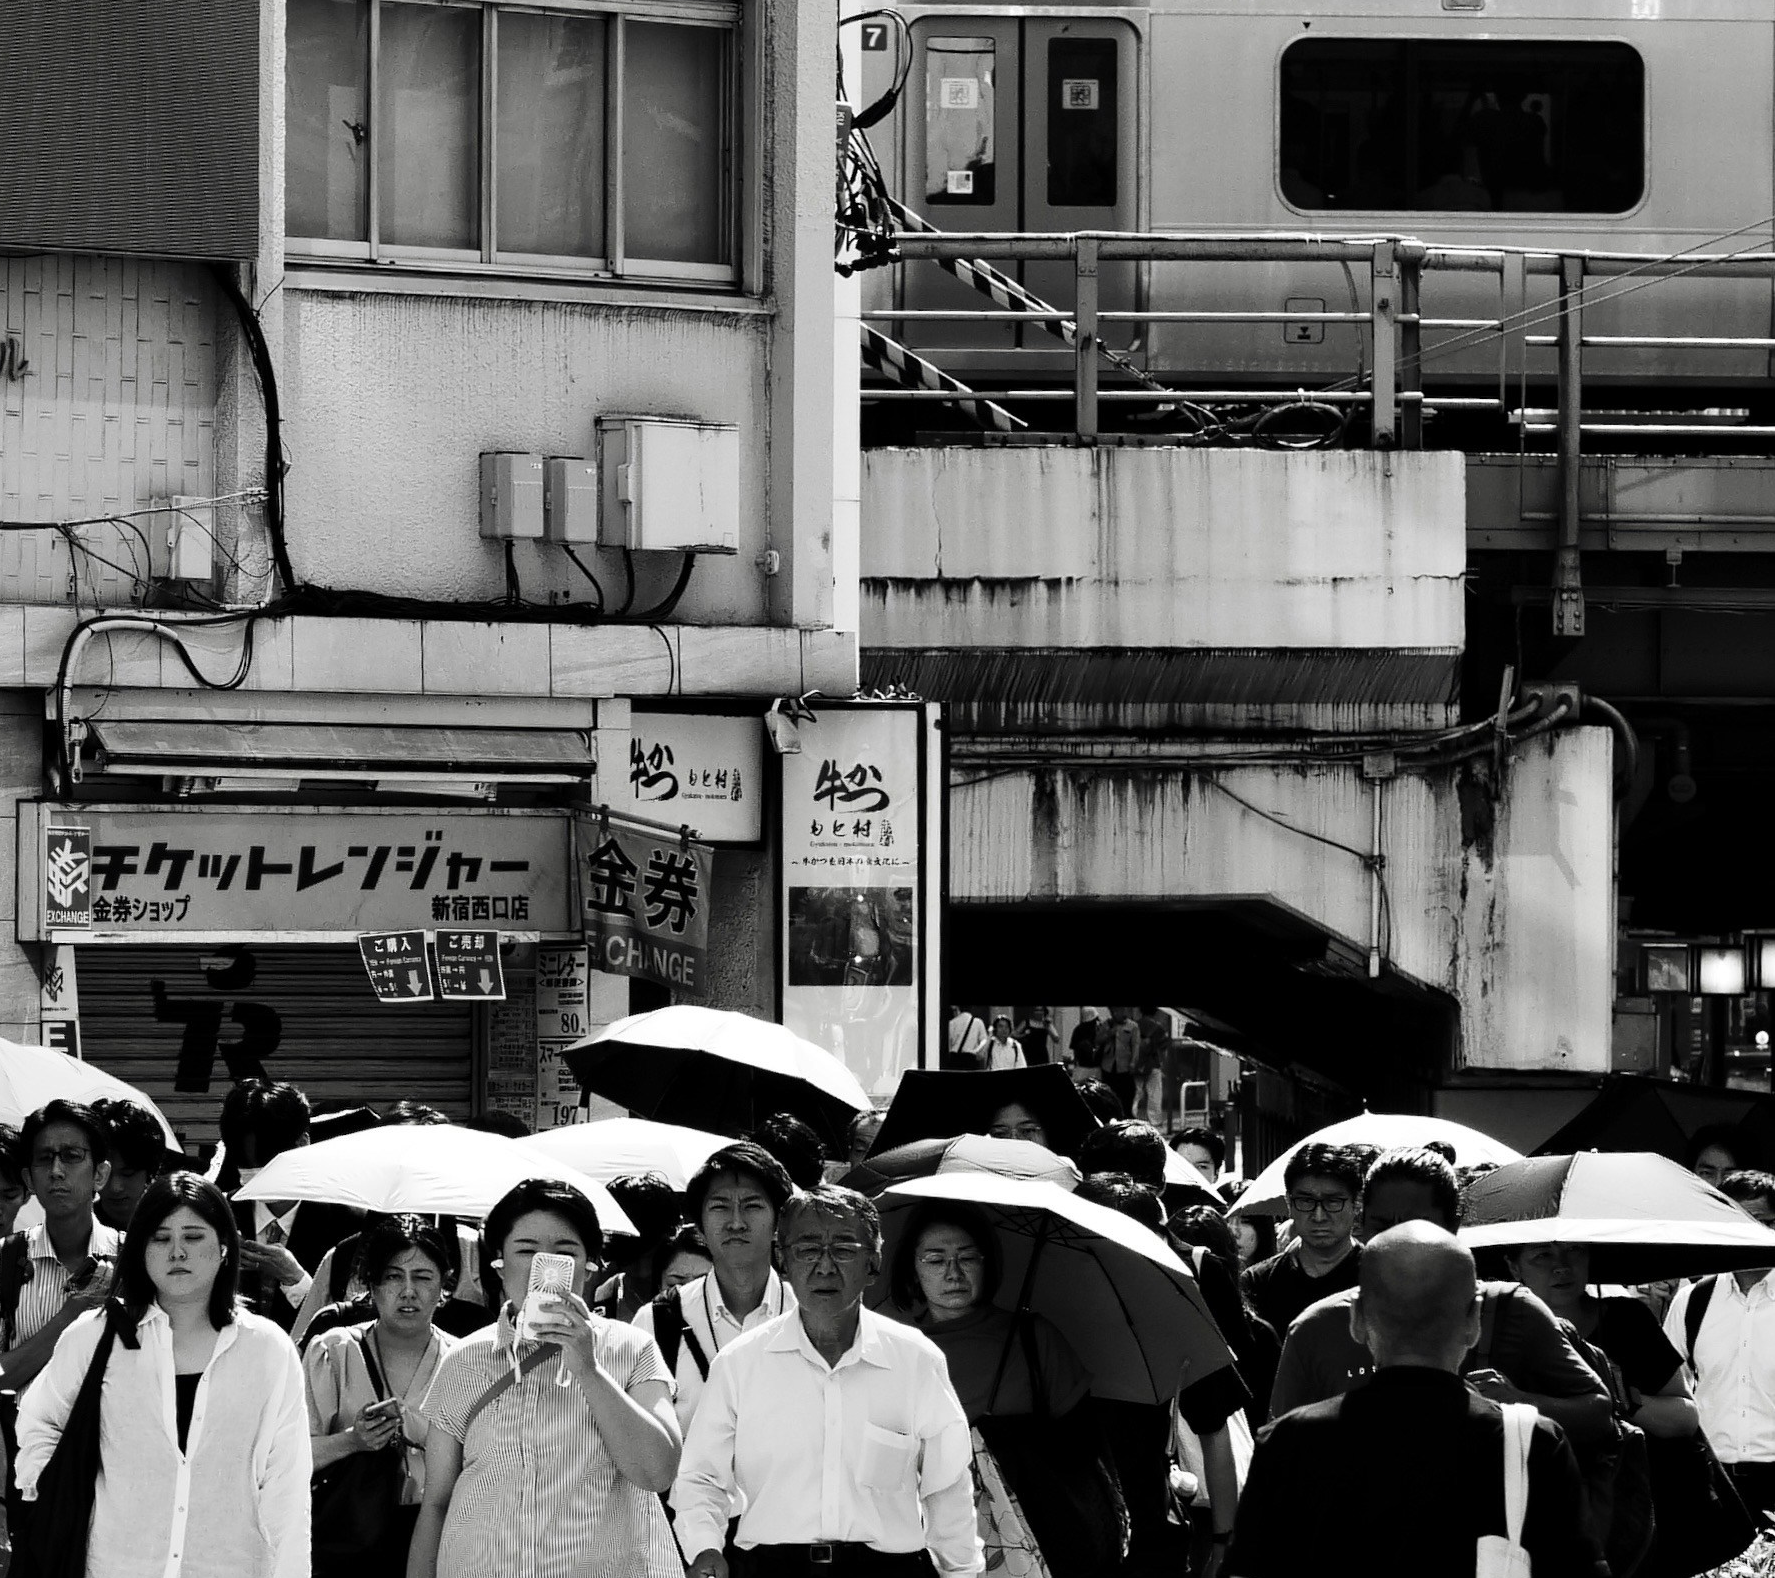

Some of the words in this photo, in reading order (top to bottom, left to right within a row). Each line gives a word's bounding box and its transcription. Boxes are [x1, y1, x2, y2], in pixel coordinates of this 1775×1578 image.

[866, 28, 882, 47] 7
[91, 830, 529, 892] チケットレンジャー
[587, 837, 700, 935] 金券
[47, 910, 90, 924] EXCHANGE
[92, 894, 191, 923] 金券ショップ
[431, 894, 529, 922] 新宿西口店
[374, 937, 411, 953] ご購入
[449, 934, 485, 951] ご売却
[538, 953, 585, 977] ミニレター
[585, 929, 695, 987] ECHANGE
[561, 1013, 580, 1033] 80
[552, 1105, 578, 1126] 197
